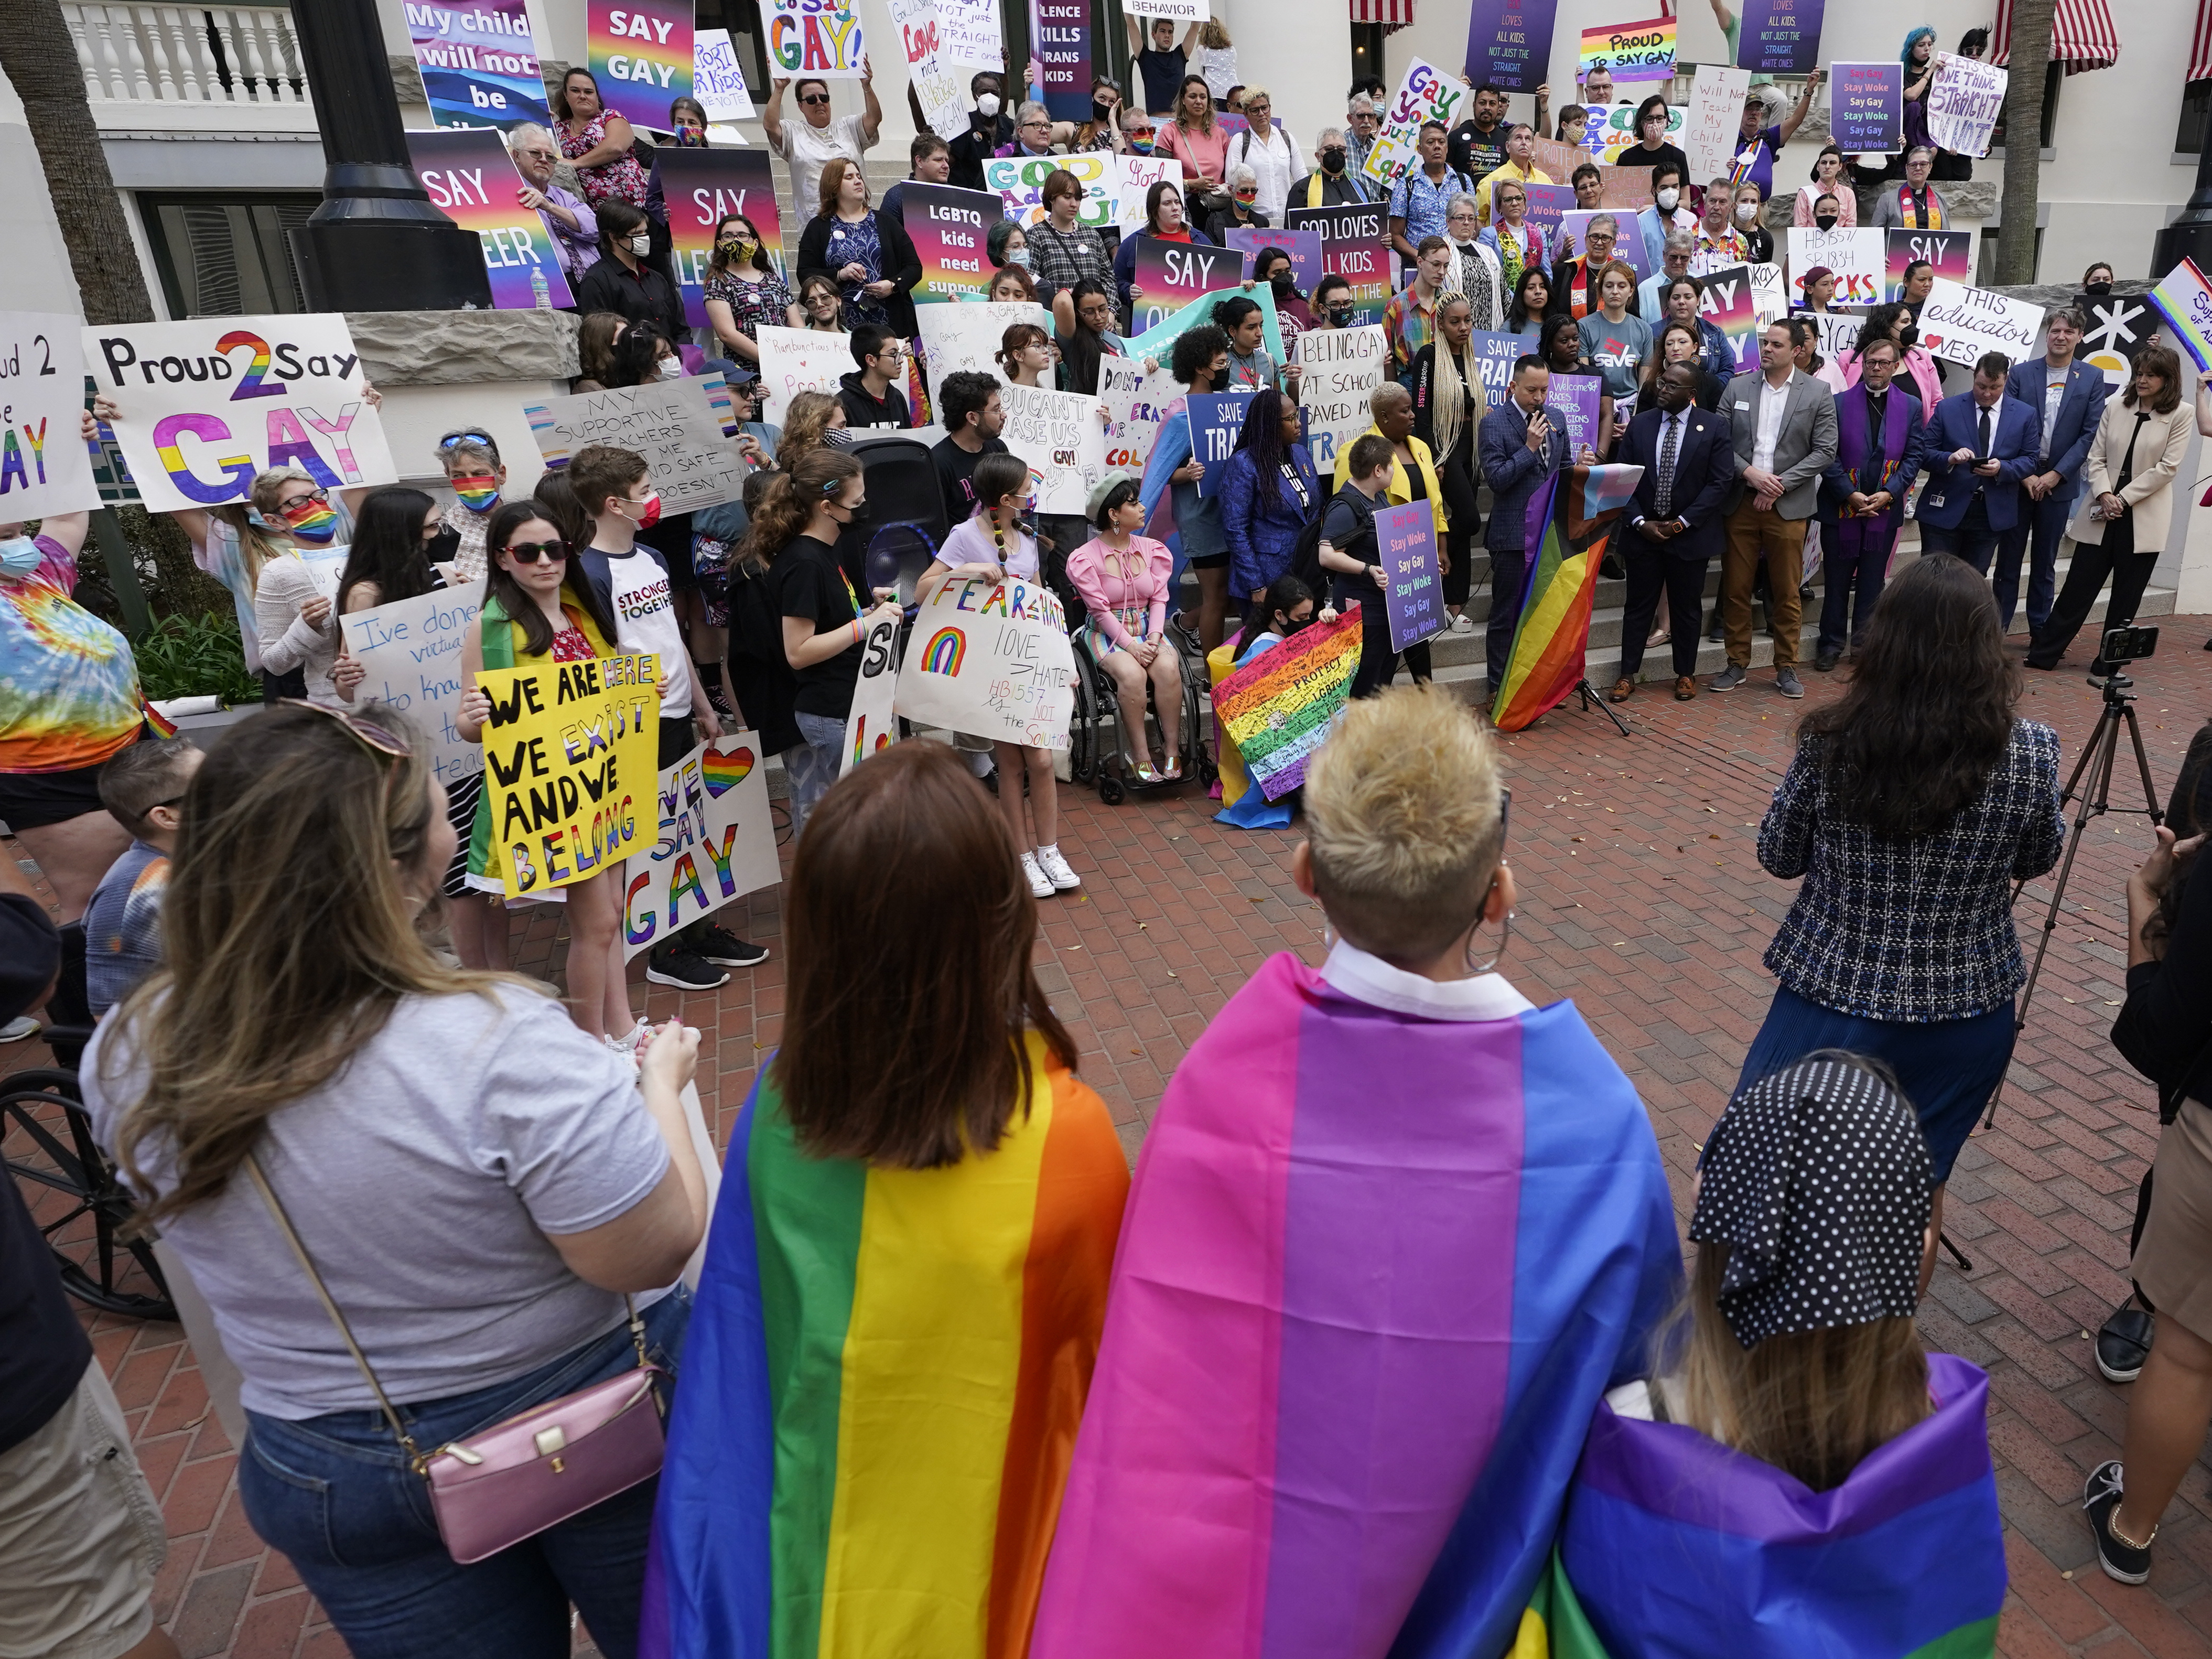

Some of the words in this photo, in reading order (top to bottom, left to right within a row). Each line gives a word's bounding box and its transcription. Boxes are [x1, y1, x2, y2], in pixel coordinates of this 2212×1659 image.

[935, 3, 966, 16] NOT
[968, 12, 992, 24] just
[1132, 1, 1195, 16] BEHAVIOR
[1773, 0, 1793, 10] LOVES
[405, 3, 451, 35] My
[460, 9, 530, 37] child
[609, 10, 673, 44] SAY
[948, 19, 966, 29] the
[1502, 15, 1522, 26] LOVES
[1768, 16, 1779, 26] ALL
[771, 14, 862, 70] GAY!
[903, 20, 939, 63] Love
[1496, 31, 1507, 42] ALL
[1610, 33, 1663, 51] PROUD
[1761, 31, 1773, 40] NOT
[1774, 31, 1788, 40] JUST
[1790, 31, 1800, 40] THE
[422, 45, 477, 69] will
[484, 55, 534, 74] not
[981, 53, 1002, 63] ones.
[1488, 47, 1501, 56] NOT
[1502, 48, 1517, 58] JUST
[1519, 49, 1529, 59] THE
[1616, 52, 1643, 66] SAY
[1645, 48, 1674, 67] GAY
[1762, 59, 1777, 68] WHITE
[1778, 59, 1793, 68] ONES
[608, 55, 675, 89] GAY
[921, 55, 938, 78] not
[1045, 71, 1073, 82] KIDS
[1718, 72, 1724, 81] I
[1850, 69, 1864, 79] Say
[1866, 70, 1883, 79] Gay
[1983, 64, 2006, 78] GET
[1490, 76, 1505, 85] WHITE
[1507, 77, 1522, 87] ONES
[1844, 83, 1862, 93] Stay
[1864, 83, 1889, 92] Woke
[1935, 68, 1960, 83] ONE
[1964, 71, 1995, 90] THING
[469, 85, 506, 109] be
[697, 96, 715, 107] WE
[715, 93, 746, 107] VOTE
[917, 74, 957, 116] Hate
[1409, 66, 1460, 120] Gay
[1700, 84, 1722, 96] Will
[1730, 89, 1746, 100] Not
[1850, 98, 1864, 107] Say
[1867, 98, 1883, 107] Gay
[944, 94, 966, 130] GAY!
[1702, 101, 1732, 113] Teach
[1929, 86, 2002, 122] STRAIGHT,
[1217, 117, 1235, 129] Say
[1705, 115, 1721, 128] My
[1844, 112, 1862, 122] Stay
[1864, 112, 1888, 120] Woke
[1380, 121, 1416, 148] just
[1691, 130, 1722, 143] Child
[1850, 126, 1864, 136] Say
[1866, 126, 1883, 136] Gay
[1470, 143, 1501, 152] GUNCLE
[1536, 139, 1589, 167] PROTECT
[1700, 145, 1713, 155] To
[1844, 140, 1862, 150] Stay
[1864, 140, 1887, 148] Woke
[988, 158, 1103, 189] GOD
[1122, 159, 1164, 190] God
[1604, 168, 1620, 181] LET
[1623, 167, 1638, 177] ME
[1691, 158, 1719, 174] LIE
[421, 168, 489, 207] SAY
[1536, 190, 1556, 202] Gay
[693, 188, 746, 225] SAY
[930, 204, 982, 228] LGBTQ
[1534, 205, 1561, 216] Woke
[1334, 214, 1379, 239] LOVES
[1536, 222, 1554, 233] Gay
[941, 230, 975, 248] kids
[1252, 234, 1272, 247] Say
[1275, 235, 1297, 247] Gay
[1612, 248, 1628, 258] Gay
[1908, 236, 1949, 265] SAY
[941, 257, 979, 272] need
[1164, 250, 1215, 289] SAY
[1340, 250, 1375, 274] KIDS,
[1360, 283, 1383, 299] THE
[1963, 286, 2008, 315] THIS
[1924, 305, 2034, 347] educator
[34, 335, 56, 376] 2
[1303, 333, 1354, 363] BEING
[1357, 330, 1385, 358] GAY
[1487, 339, 1518, 357] SAVE
[215, 330, 286, 401] 2
[274, 343, 358, 381] Say
[1105, 368, 1143, 391] DONT
[1301, 375, 1324, 396] AT
[1552, 376, 1588, 392] Welcome
[588, 390, 636, 416] MY
[1028, 391, 1086, 422] CAN'T
[1549, 391, 1571, 402] RACES
[1217, 402, 1244, 423] SAVE
[555, 405, 687, 442] SUPPORTIVE
[1051, 422, 1081, 446] US
[584, 425, 684, 449] TEACHERS
[153, 402, 363, 503] GAY
[659, 443, 686, 458] ME
[1053, 450, 1075, 466] GAY!
[681, 452, 725, 472] SAFE
[655, 470, 738, 499] DOESN'T
[1393, 515, 1405, 528] Say
[1406, 511, 1419, 524] Gay
[1390, 538, 1406, 552] Stay
[1407, 531, 1426, 546] Woke
[1398, 560, 1410, 574] Say
[1412, 555, 1425, 569] Gay
[1397, 583, 1412, 597] Stay
[1412, 575, 1431, 591] Woke
[1404, 605, 1416, 618] Say
[1418, 598, 1430, 612] Gay
[353, 618, 408, 653] I've
[424, 605, 478, 633] done
[1403, 628, 1417, 642] Stay
[1419, 618, 1437, 633] Woke
[1033, 662, 1069, 688] HATE
[1292, 655, 1342, 690] PROTECT
[383, 682, 411, 710] to
[481, 677, 545, 729] WE
[557, 664, 601, 705] ARE
[602, 656, 654, 689] HERE.
[981, 694, 1011, 712] is
[1033, 705, 1055, 721] NOT
[1002, 714, 1024, 728] the
[487, 737, 549, 788] WE
[659, 759, 703, 817] WE
[651, 799, 706, 861] SAY
[513, 795, 638, 892] BELONG.
[627, 824, 738, 945] GAY
